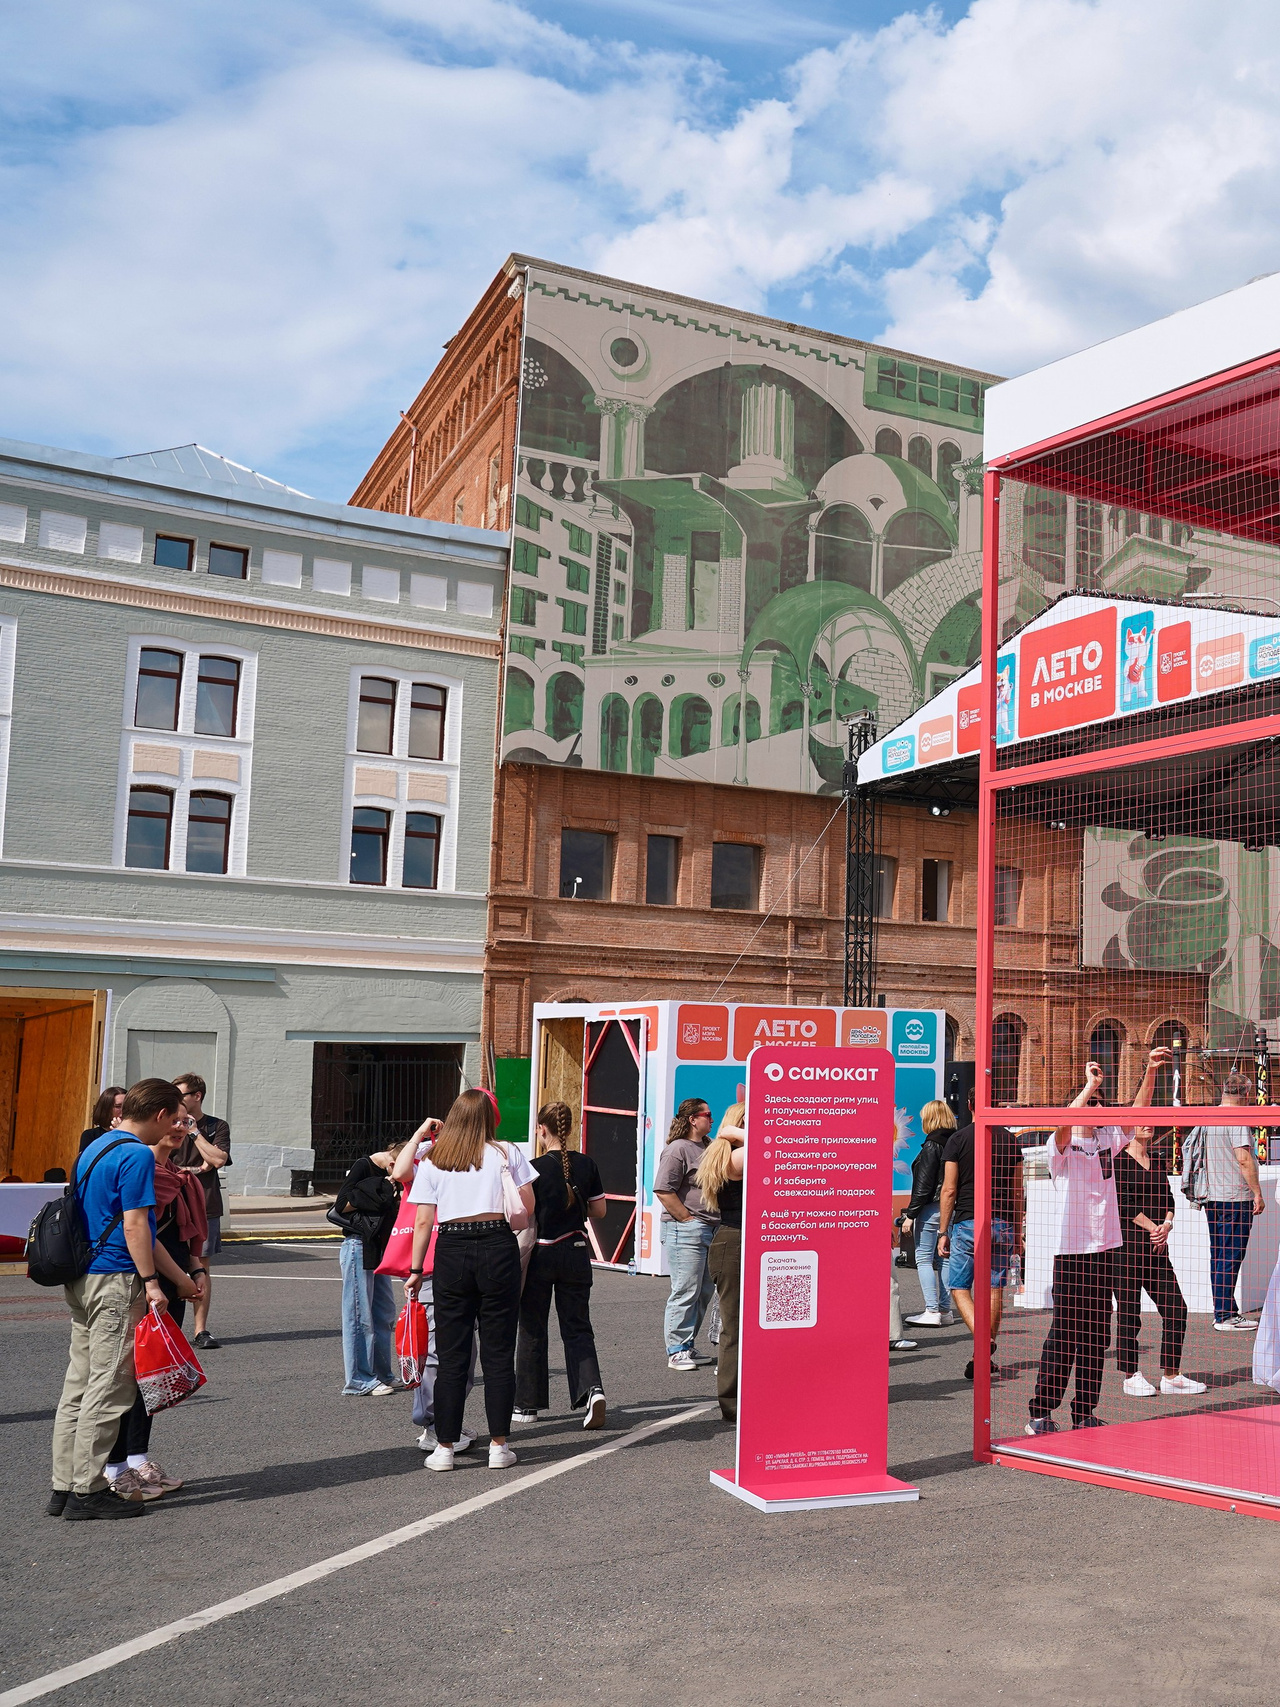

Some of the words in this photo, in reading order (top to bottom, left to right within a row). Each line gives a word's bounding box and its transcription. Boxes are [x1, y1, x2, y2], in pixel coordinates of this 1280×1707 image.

[1031, 640, 1103, 687] ЛЕТО
[1030, 692, 1040, 708] В
[1043, 674, 1103, 705] МОСКВЕ
[754, 1019, 818, 1038] ЛЕТО
[788, 1066, 879, 1081] самокат
[764, 1095, 791, 1104] Здесь
[793, 1096, 832, 1104] создают
[834, 1096, 855, 1105] ритм
[857, 1096, 879, 1105] улиц
[772, 1108, 817, 1116] получают
[818, 1107, 857, 1116] подарки
[775, 1118, 822, 1126] Самоката
[775, 1135, 820, 1145] Скачайте
[821, 1136, 877, 1145] приложение
[775, 1151, 821, 1159] Покажите
[822, 1152, 837, 1160] его
[774, 1161, 877, 1172] ребятам-промоутерам
[774, 1177, 782, 1185] И
[783, 1177, 827, 1186] заберите
[773, 1187, 835, 1198] освежающий
[836, 1188, 876, 1198] подарок
[761, 1210, 769, 1218] А
[770, 1209, 789, 1220] ещё
[791, 1211, 805, 1220] тут
[806, 1210, 837, 1218] можно
[838, 1209, 880, 1218] поиграть
[768, 1220, 817, 1231] баскетбол
[837, 1221, 870, 1230] просто
[760, 1234, 809, 1243] отдохнуть.
